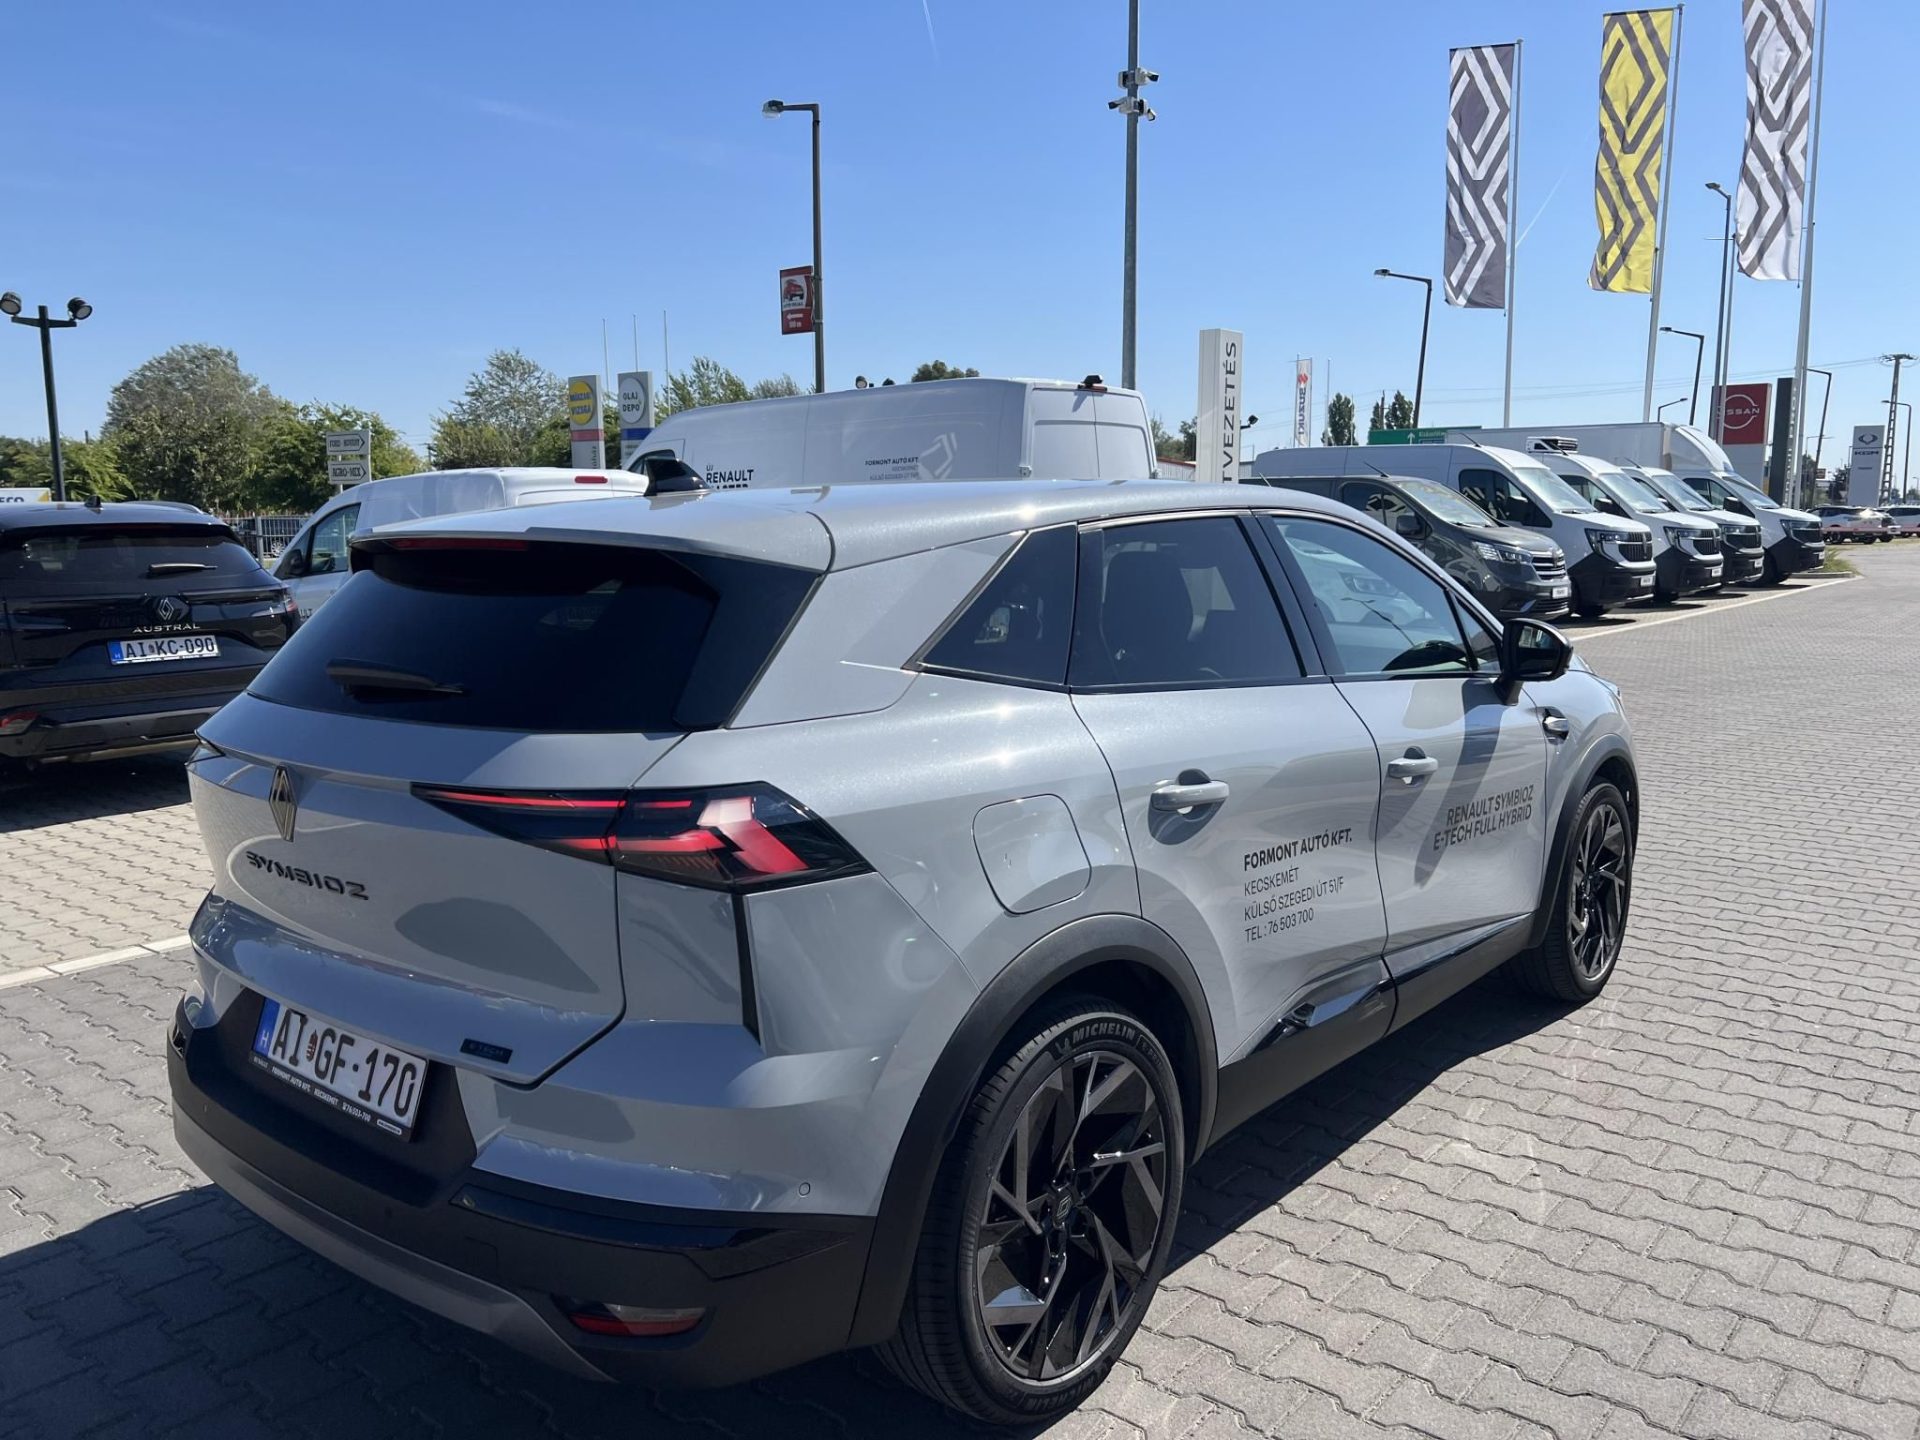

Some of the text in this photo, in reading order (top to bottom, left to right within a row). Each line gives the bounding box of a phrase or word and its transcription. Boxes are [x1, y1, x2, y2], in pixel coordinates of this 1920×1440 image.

[622, 391, 638, 401] OLAJ
[1725, 406, 1760, 417] SSAN
[706, 469, 754, 483] RENAULT
[132, 623, 201, 634] AUSTRAL
[1446, 784, 1534, 826] RENAULT SYMBIOZ
[1433, 804, 1532, 851] E-TECH FULL HYBRID
[1244, 827, 1353, 871] FORMONT AUTÓ KFT.
[246, 850, 370, 900] SYMBIOZ
[1244, 865, 1300, 896] KECSKEMÉT
[1244, 895, 1277, 921] KÜLSŐ
[1278, 886, 1316, 910] SZEGEDI
[1267, 920, 1279, 935] 76
[1279, 912, 1297, 931] 503
[1297, 907, 1314, 925] 700
[1073, 1022, 1136, 1044] MICHELIN
